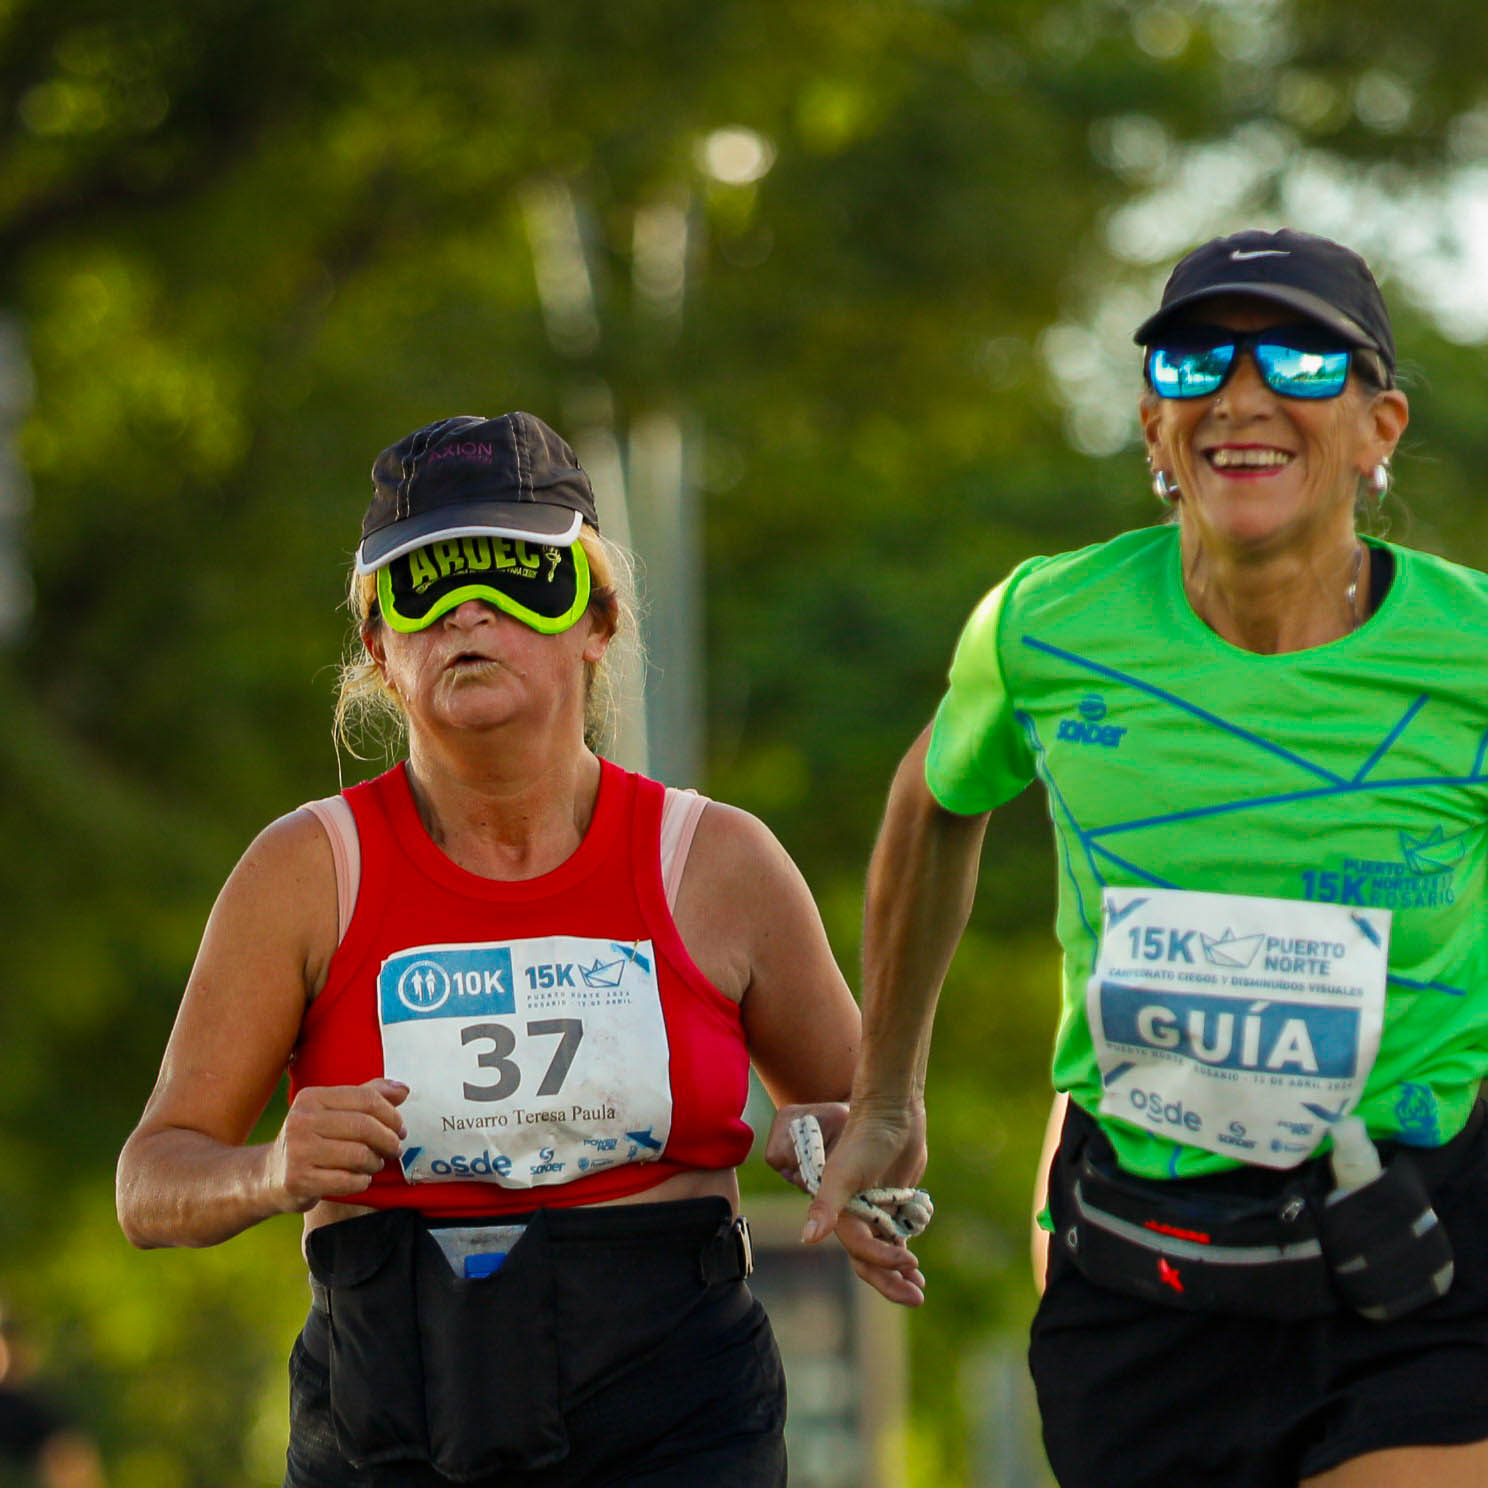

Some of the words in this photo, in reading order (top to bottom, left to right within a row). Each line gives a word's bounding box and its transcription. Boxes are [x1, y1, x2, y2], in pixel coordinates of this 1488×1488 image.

[1302, 869, 1369, 905] 15K
[1129, 926, 1200, 964] 15K
[1266, 936, 1345, 958] PUERTO
[525, 963, 576, 989] 15K
[1178, 971, 1218, 984] CIEGOS
[1265, 956, 1331, 976] NORTE
[452, 969, 505, 996] 10K
[1137, 1000, 1320, 1073] GUÍA
[461, 1018, 584, 1102] 37
[442, 1115, 508, 1132] Navarro
[512, 1109, 566, 1125] Teresa
[572, 1104, 616, 1121] Paula
[1130, 1088, 1202, 1132] osde
[431, 1150, 513, 1176] osde
